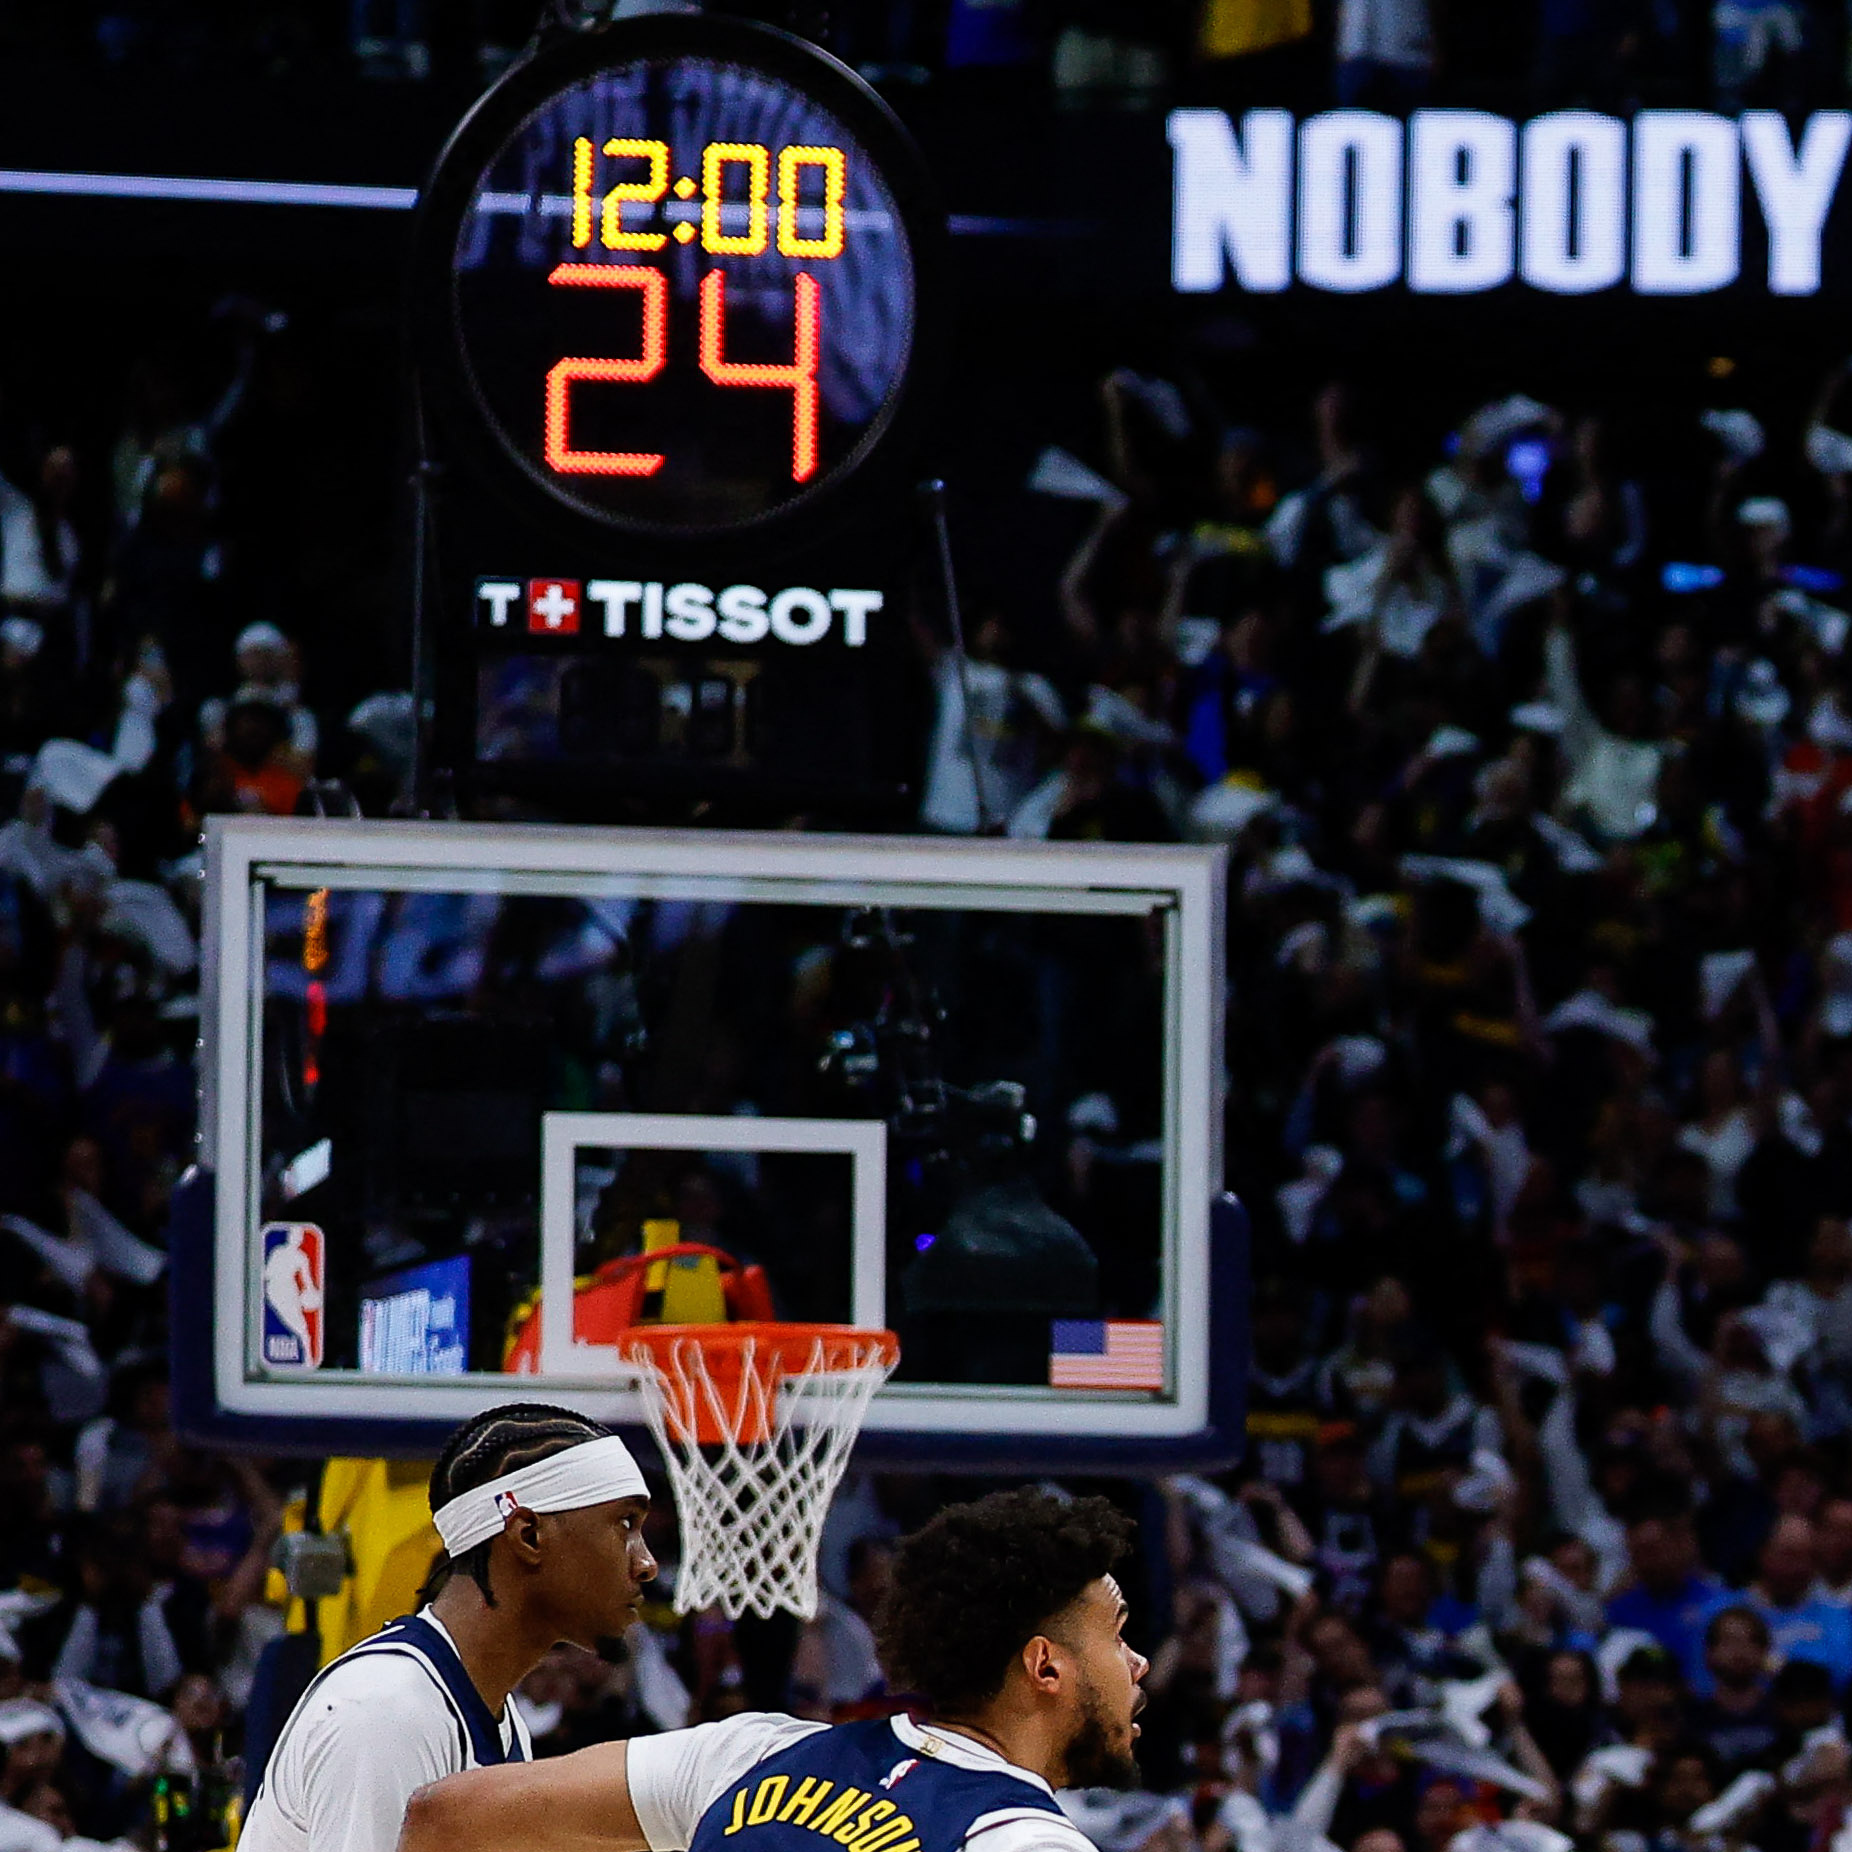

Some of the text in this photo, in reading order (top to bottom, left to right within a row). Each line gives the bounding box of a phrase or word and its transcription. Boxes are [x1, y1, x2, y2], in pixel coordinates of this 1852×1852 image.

[572, 136, 846, 259] 12:00
[545, 262, 821, 483] 24
[586, 579, 884, 647] TISSOT
